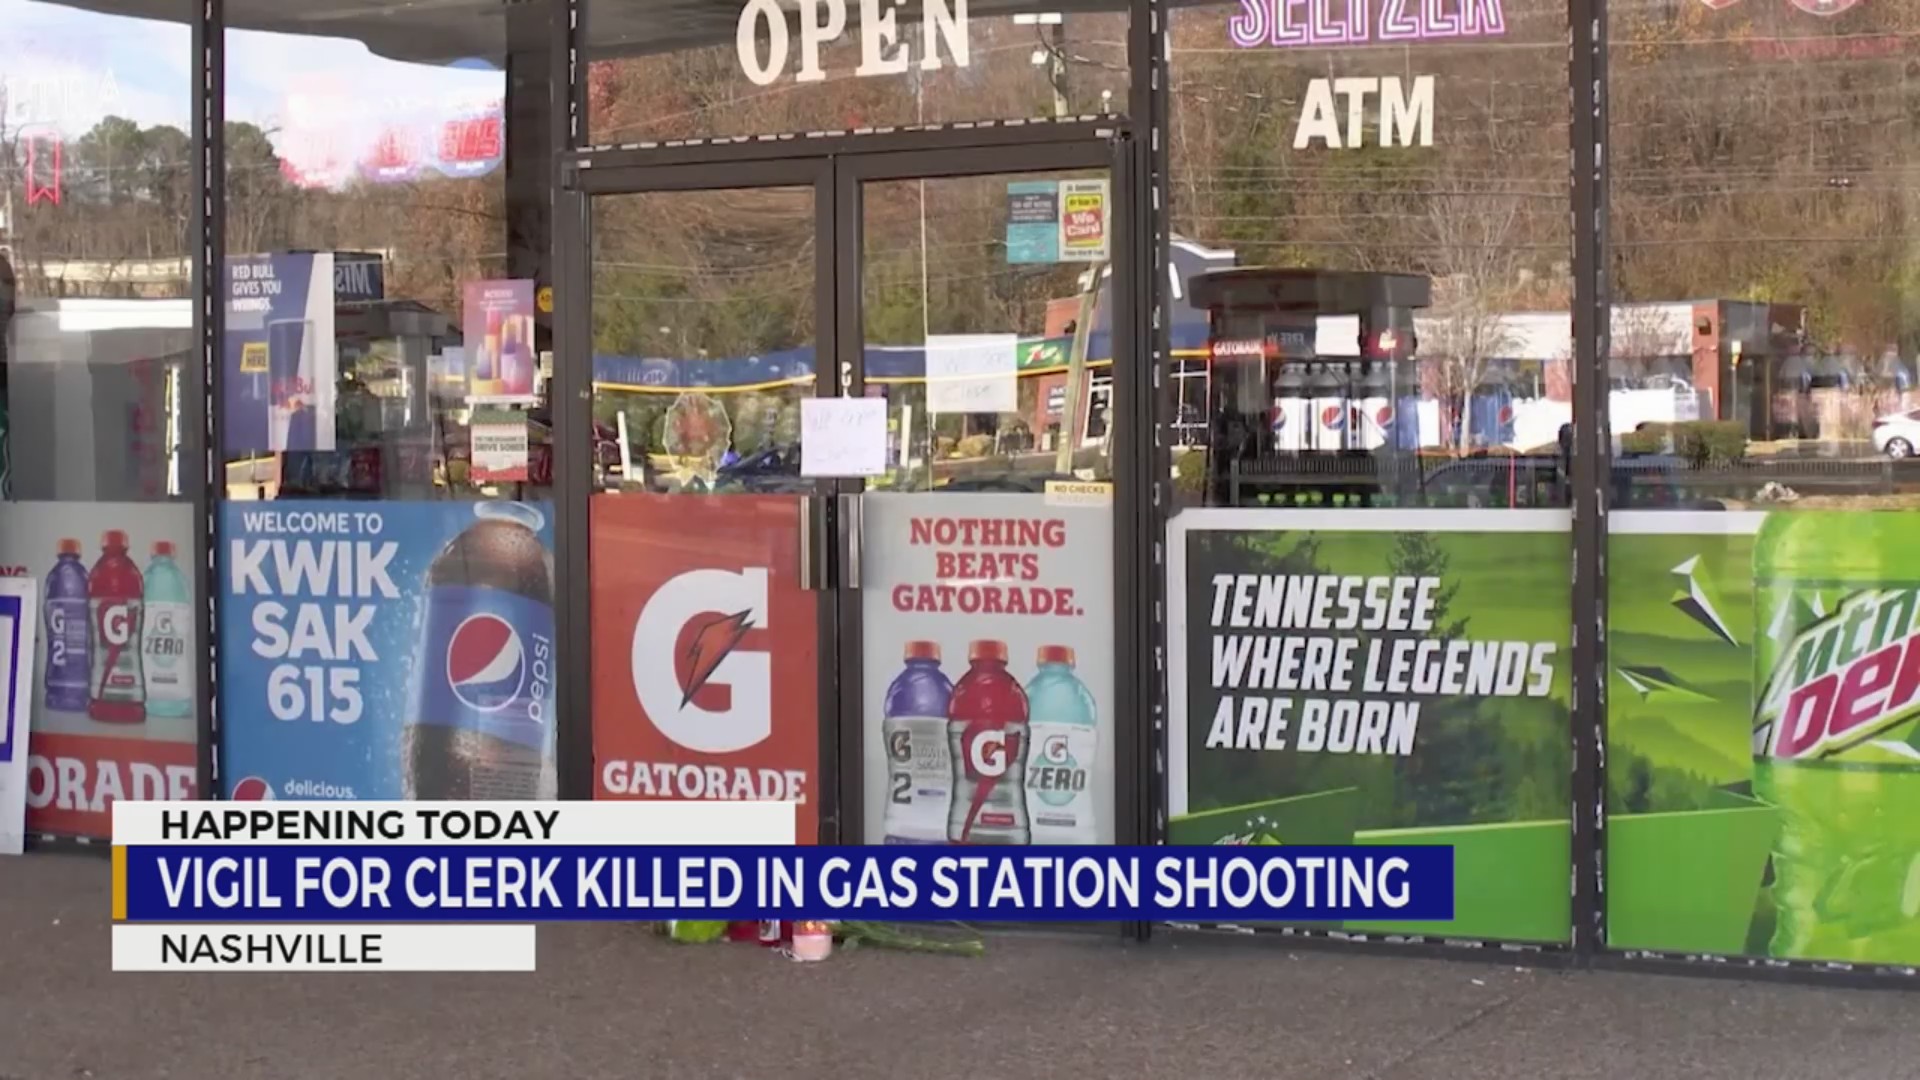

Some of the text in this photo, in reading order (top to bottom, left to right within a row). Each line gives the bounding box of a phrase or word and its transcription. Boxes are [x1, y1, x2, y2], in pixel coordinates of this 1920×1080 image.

[737, 0, 970, 85] OPEN
[1294, 76, 1434, 148] ATM
[232, 264, 275, 279] RED BULL
[232, 280, 281, 295] GIVES YOU
[841, 361, 852, 398] PUL
[1054, 485, 1105, 494] NO CHECKS
[243, 512, 383, 534] WELCOME TO
[910, 517, 1066, 547] NOTHING
[231, 539, 400, 598] KWIK
[936, 551, 1039, 581] BEATS
[892, 584, 1084, 616] GATORADE.
[1210, 574, 1441, 631] TENNESSEE
[50, 607, 65, 634] G
[102, 604, 130, 645] G
[154, 610, 173, 635] G
[251, 601, 379, 661] SAK
[52, 639, 66, 666] 2
[145, 636, 184, 656] ZERO
[632, 567, 771, 753] G
[528, 633, 550, 723] pepsi
[1211, 635, 1557, 696] WHERE LEGENDS
[267, 664, 364, 725] 615
[1206, 696, 1420, 756] ARE BORN
[890, 729, 912, 762] G
[970, 729, 1006, 776] G
[1043, 734, 1069, 765] G
[27, 754, 197, 813] ORADE
[284, 779, 357, 799] delicious.
[603, 760, 807, 804] GATORADE
[893, 772, 912, 804] 2
[1027, 766, 1086, 792] ZERO
